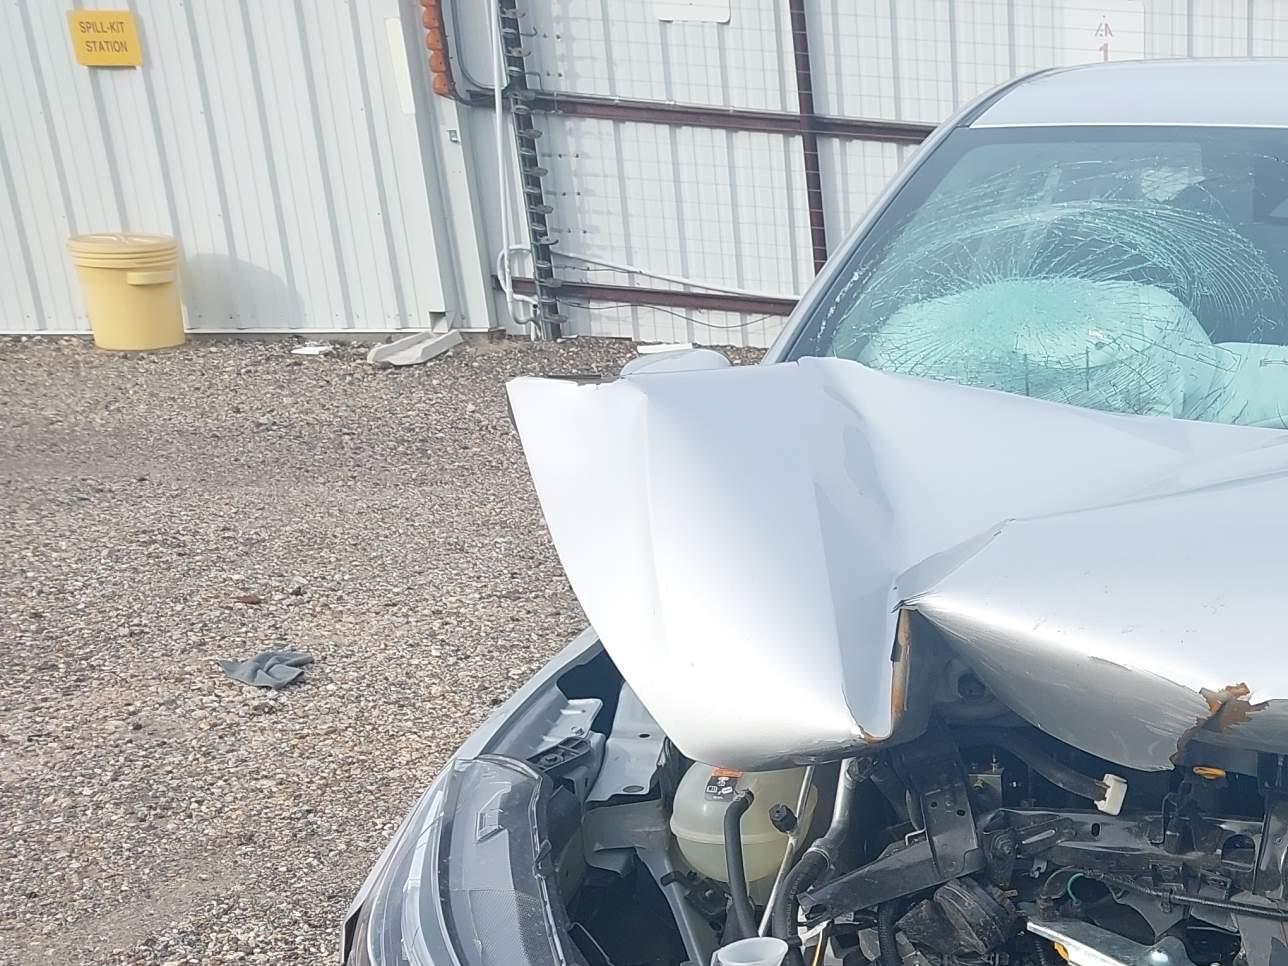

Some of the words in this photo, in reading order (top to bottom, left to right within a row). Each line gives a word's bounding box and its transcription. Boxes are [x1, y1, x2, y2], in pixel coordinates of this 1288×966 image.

[79, 21, 125, 33] SPILL-KIT
[85, 40, 128, 53] STATION
[1099, 43, 1108, 62] 1
